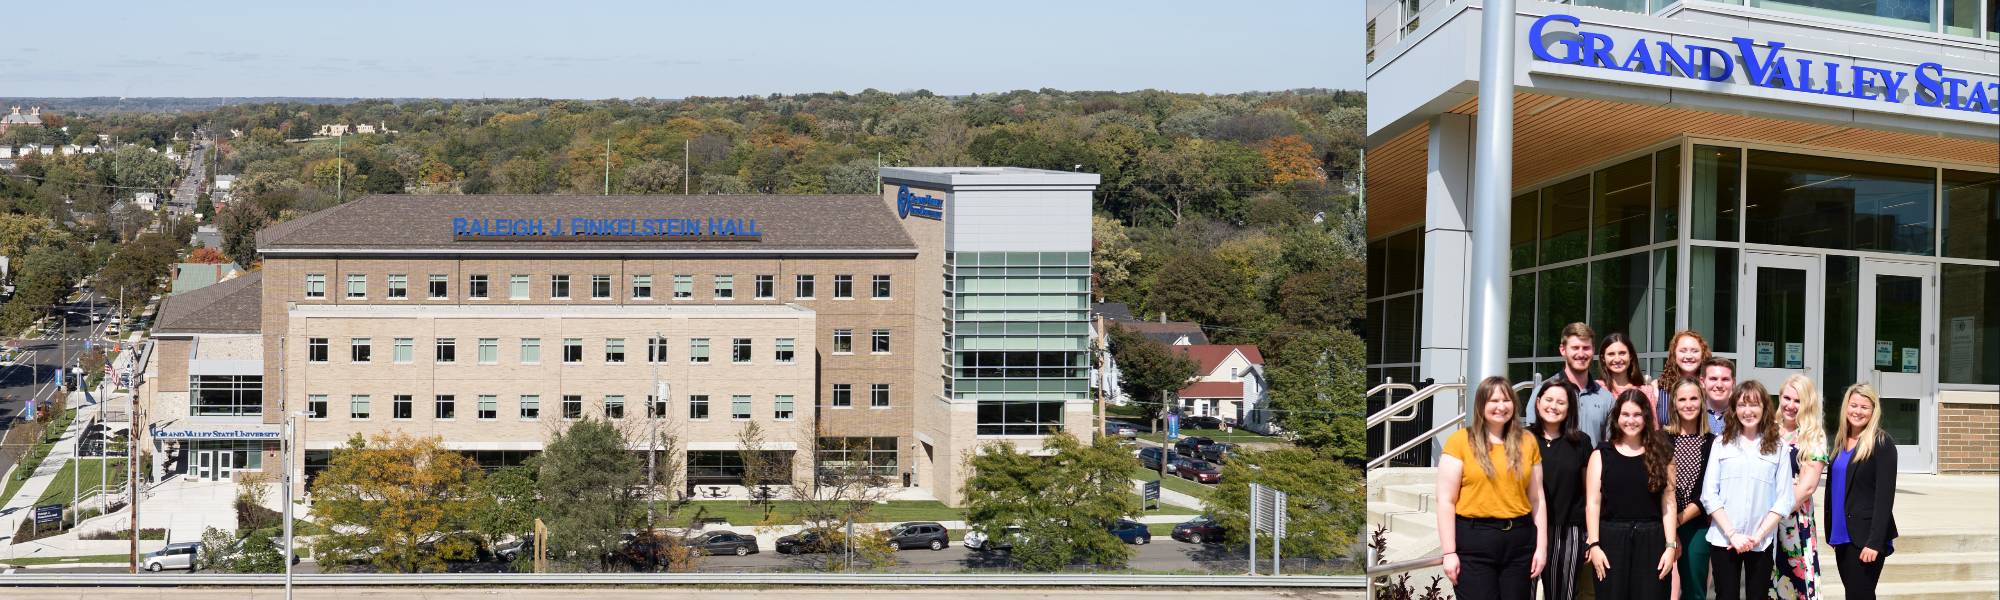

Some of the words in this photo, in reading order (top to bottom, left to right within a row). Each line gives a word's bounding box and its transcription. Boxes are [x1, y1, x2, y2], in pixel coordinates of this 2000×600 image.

[1529, 14, 1734, 83] GRAND
[1733, 37, 1907, 104] VALLEY
[453, 217, 543, 236] RALEIGH
[571, 217, 701, 236] FINKELSTEIN
[708, 217, 762, 236] HALL
